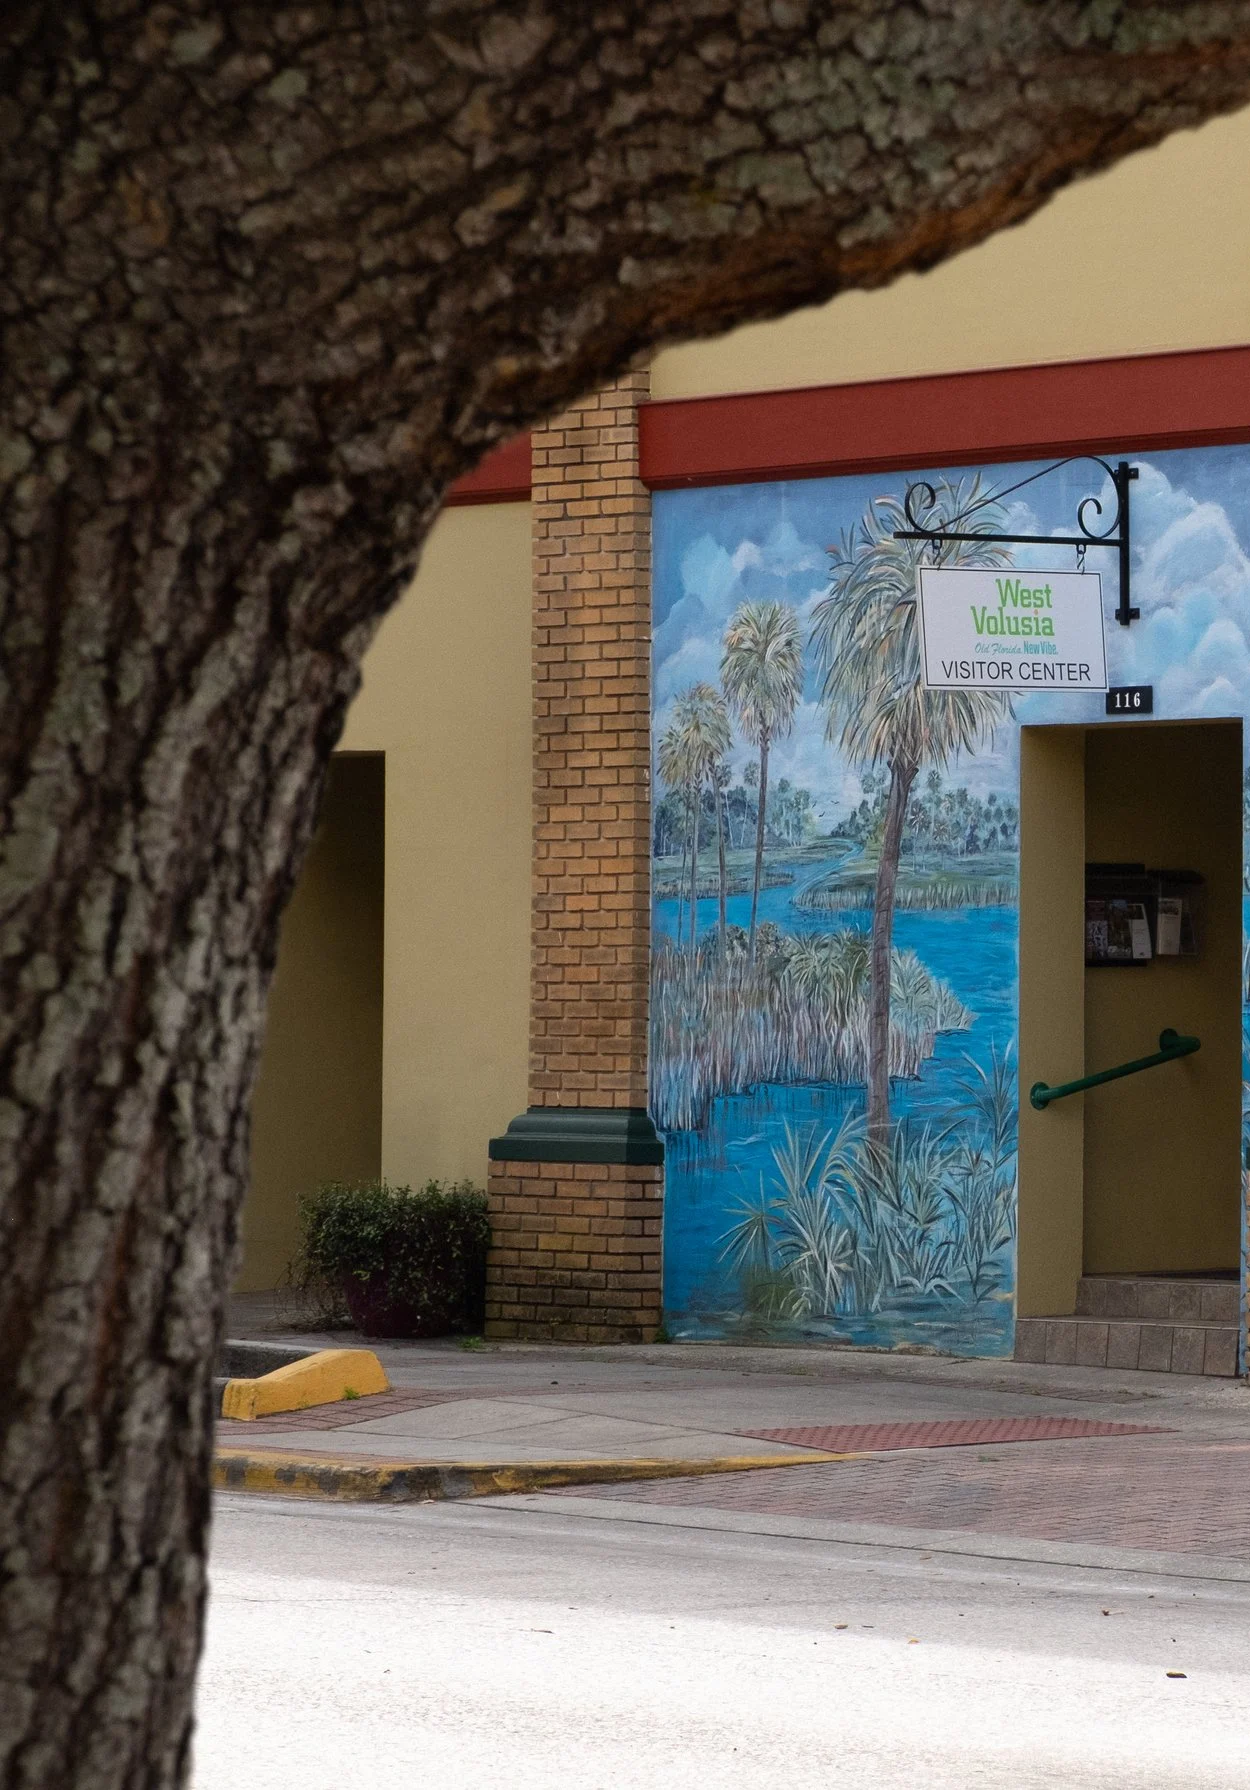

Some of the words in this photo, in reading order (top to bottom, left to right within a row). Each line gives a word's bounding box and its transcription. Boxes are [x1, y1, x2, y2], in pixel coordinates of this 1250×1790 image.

[995, 578, 1053, 609] West
[970, 605, 1055, 637] Volusia
[974, 642, 991, 654] Old
[1023, 640, 1040, 654] New
[941, 660, 1014, 680] VISITOR
[1018, 662, 1092, 682] CENTER
[1114, 691, 1141, 709] 116
